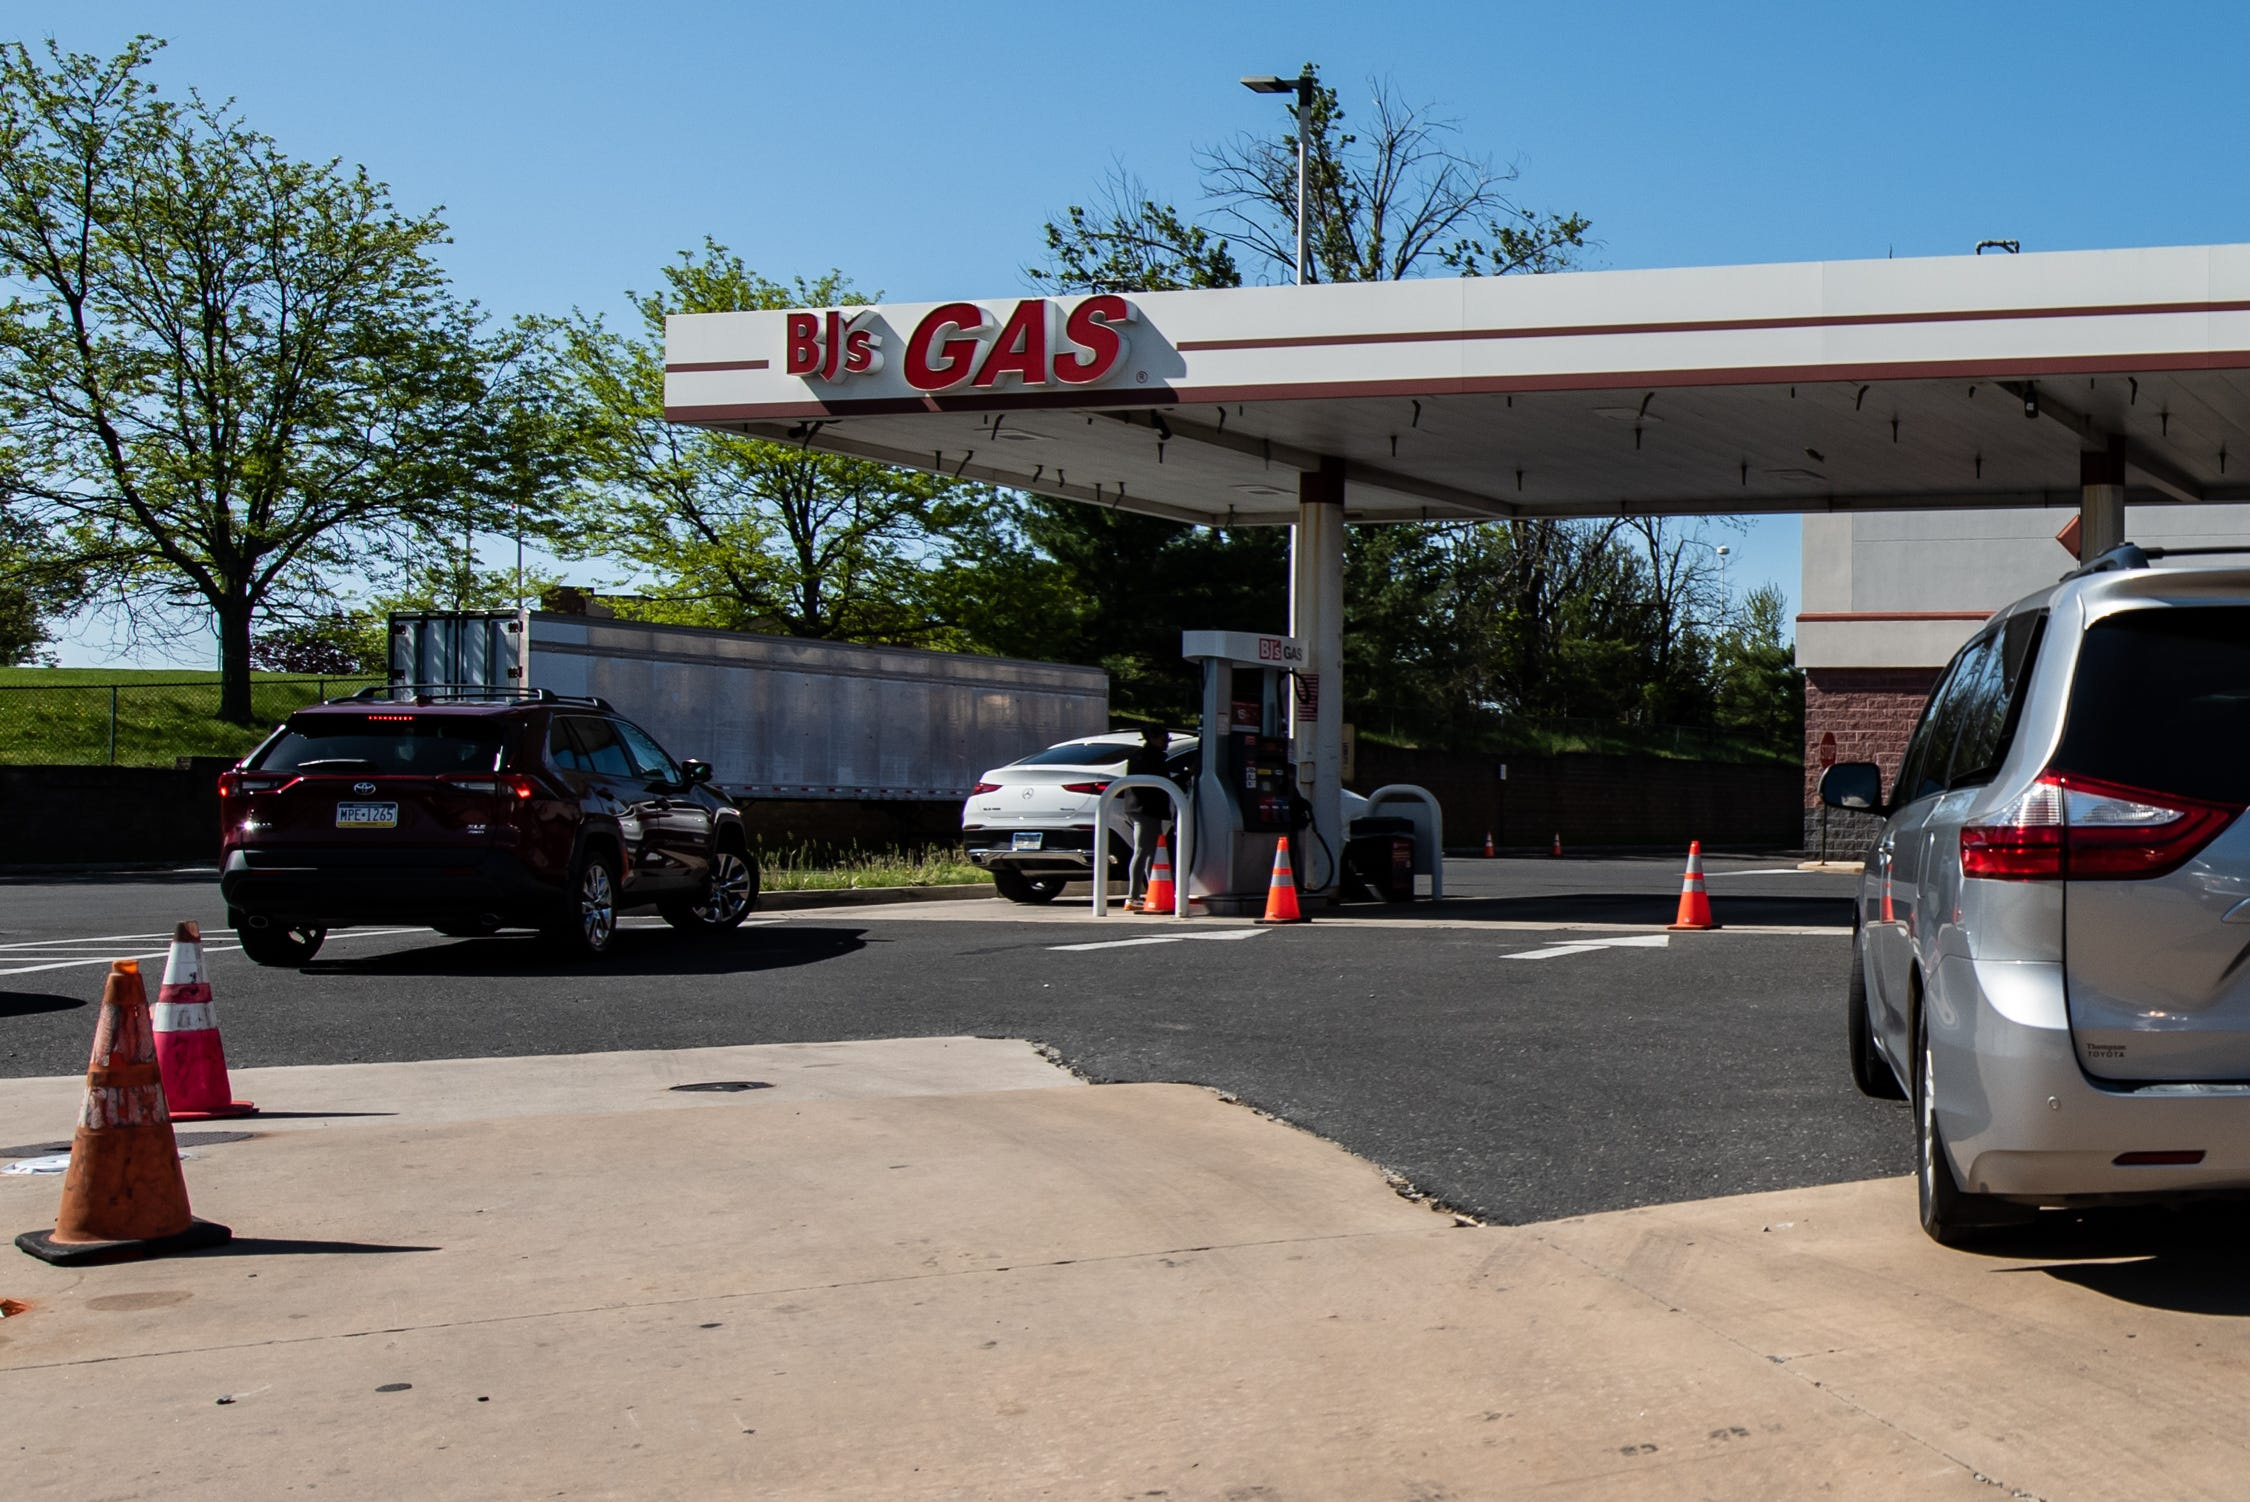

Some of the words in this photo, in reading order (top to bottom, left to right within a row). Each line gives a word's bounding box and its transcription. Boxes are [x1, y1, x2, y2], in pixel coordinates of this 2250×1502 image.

[787, 308, 884, 384] BJ's
[904, 294, 1136, 392] GAS
[1261, 639, 1281, 660] BJ's
[1283, 645, 1303, 661] GAS
